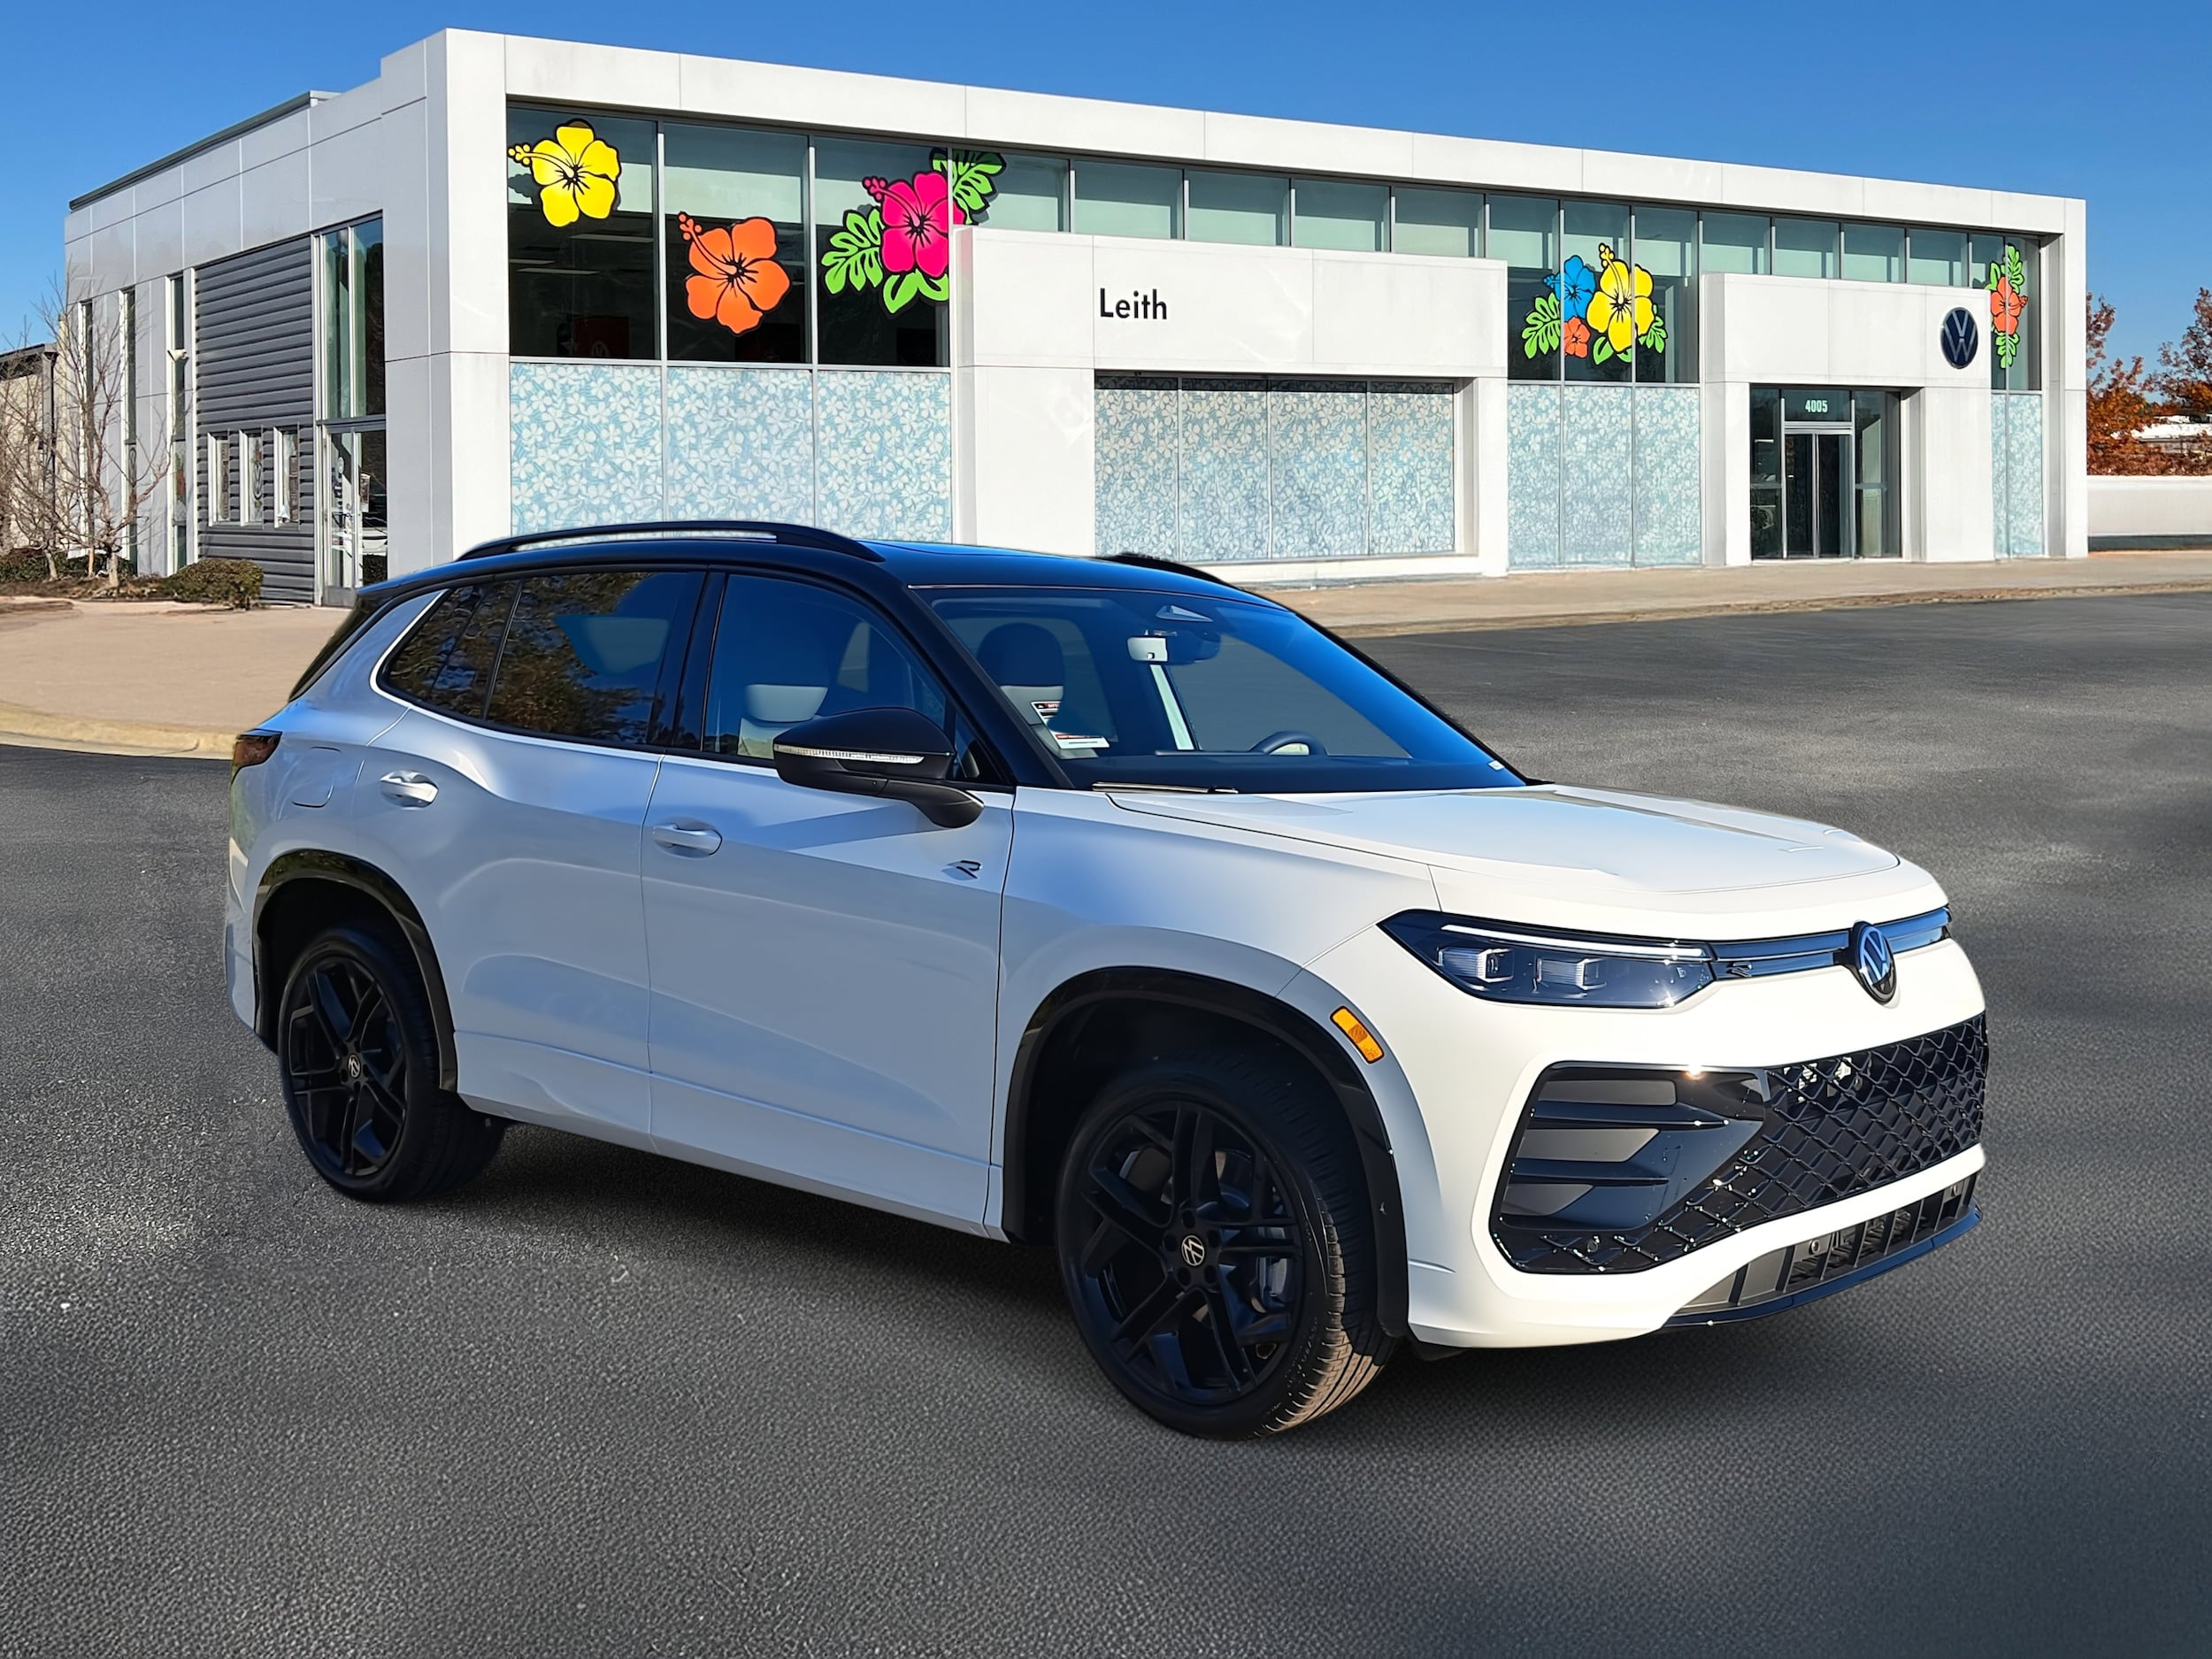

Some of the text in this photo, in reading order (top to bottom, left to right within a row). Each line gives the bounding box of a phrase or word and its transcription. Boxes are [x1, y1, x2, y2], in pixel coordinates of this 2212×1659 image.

[1100, 288, 1167, 320] Leith
[1941, 308, 1978, 366] VW
[1804, 399, 1828, 413] 4005
